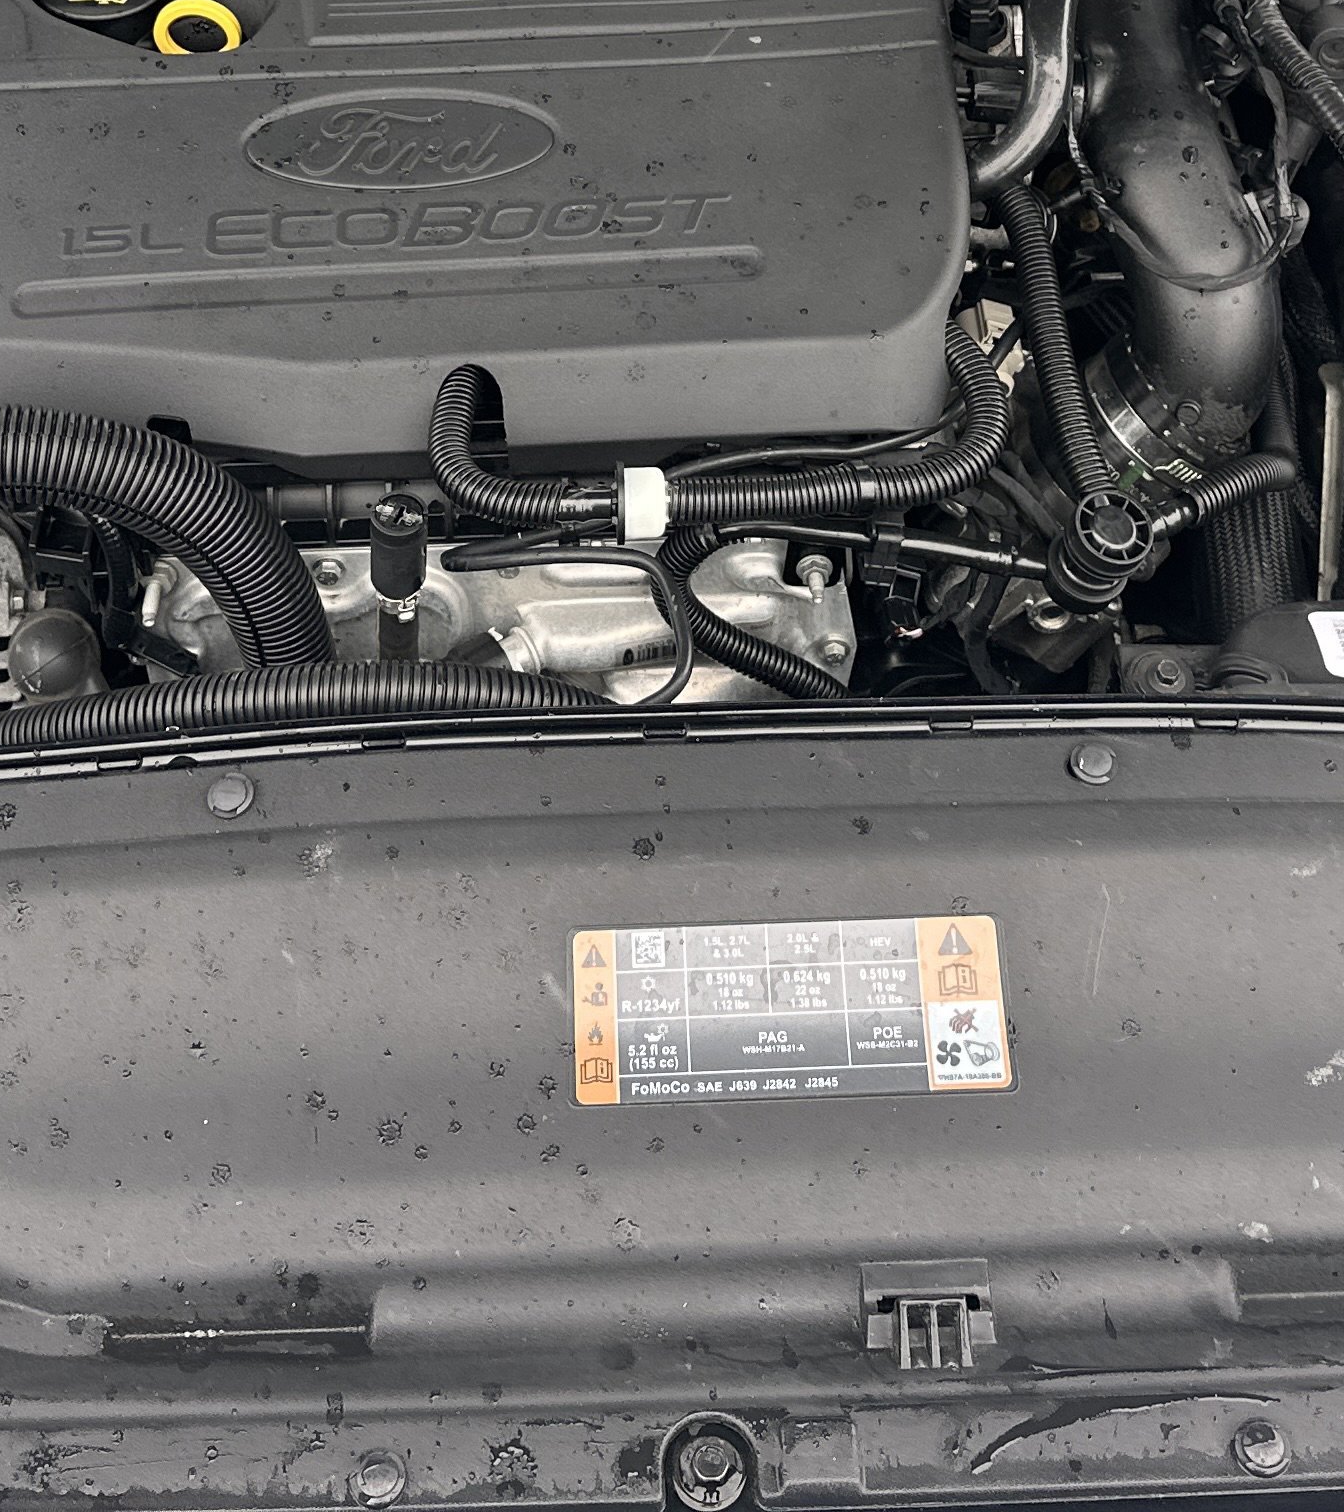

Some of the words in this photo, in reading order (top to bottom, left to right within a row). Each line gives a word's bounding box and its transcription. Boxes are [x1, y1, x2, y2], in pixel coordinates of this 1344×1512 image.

[299, 106, 506, 175] Ford
[729, 935, 750, 946] 2.7L
[870, 936, 892, 947] HEV
[706, 972, 737, 986] 0.510
[739, 972, 754, 987] kg
[783, 970, 814, 984] 0.624
[816, 969, 831, 984] kg
[860, 968, 890, 981] 0.510
[892, 967, 906, 981] kg
[718, 988, 730, 997] 18
[732, 988, 744, 997] oz
[795, 985, 807, 995] 22
[809, 986, 821, 995] oz
[885, 982, 897, 992] oz
[621, 998, 681, 1013] R-1234yf
[712, 1000, 733, 1011] 1.12
[735, 1000, 750, 1010] lbs
[812, 997, 827, 1008] lbs
[867, 995, 887, 1005] 1.12
[888, 994, 903, 1004] lbs
[758, 1031, 787, 1044] PAG
[872, 1026, 902, 1039] POE
[628, 1044, 647, 1057] 5.2
[650, 1044, 658, 1056] fl
[662, 1045, 677, 1056] oz
[629, 1056, 656, 1071] (155
[659, 1055, 679, 1070] cc)
[631, 1080, 690, 1095] FoMoCo
[696, 1080, 723, 1092] SAE
[729, 1079, 757, 1092] J639
[762, 1078, 797, 1090] J2842
[805, 1076, 839, 1089] J2845
